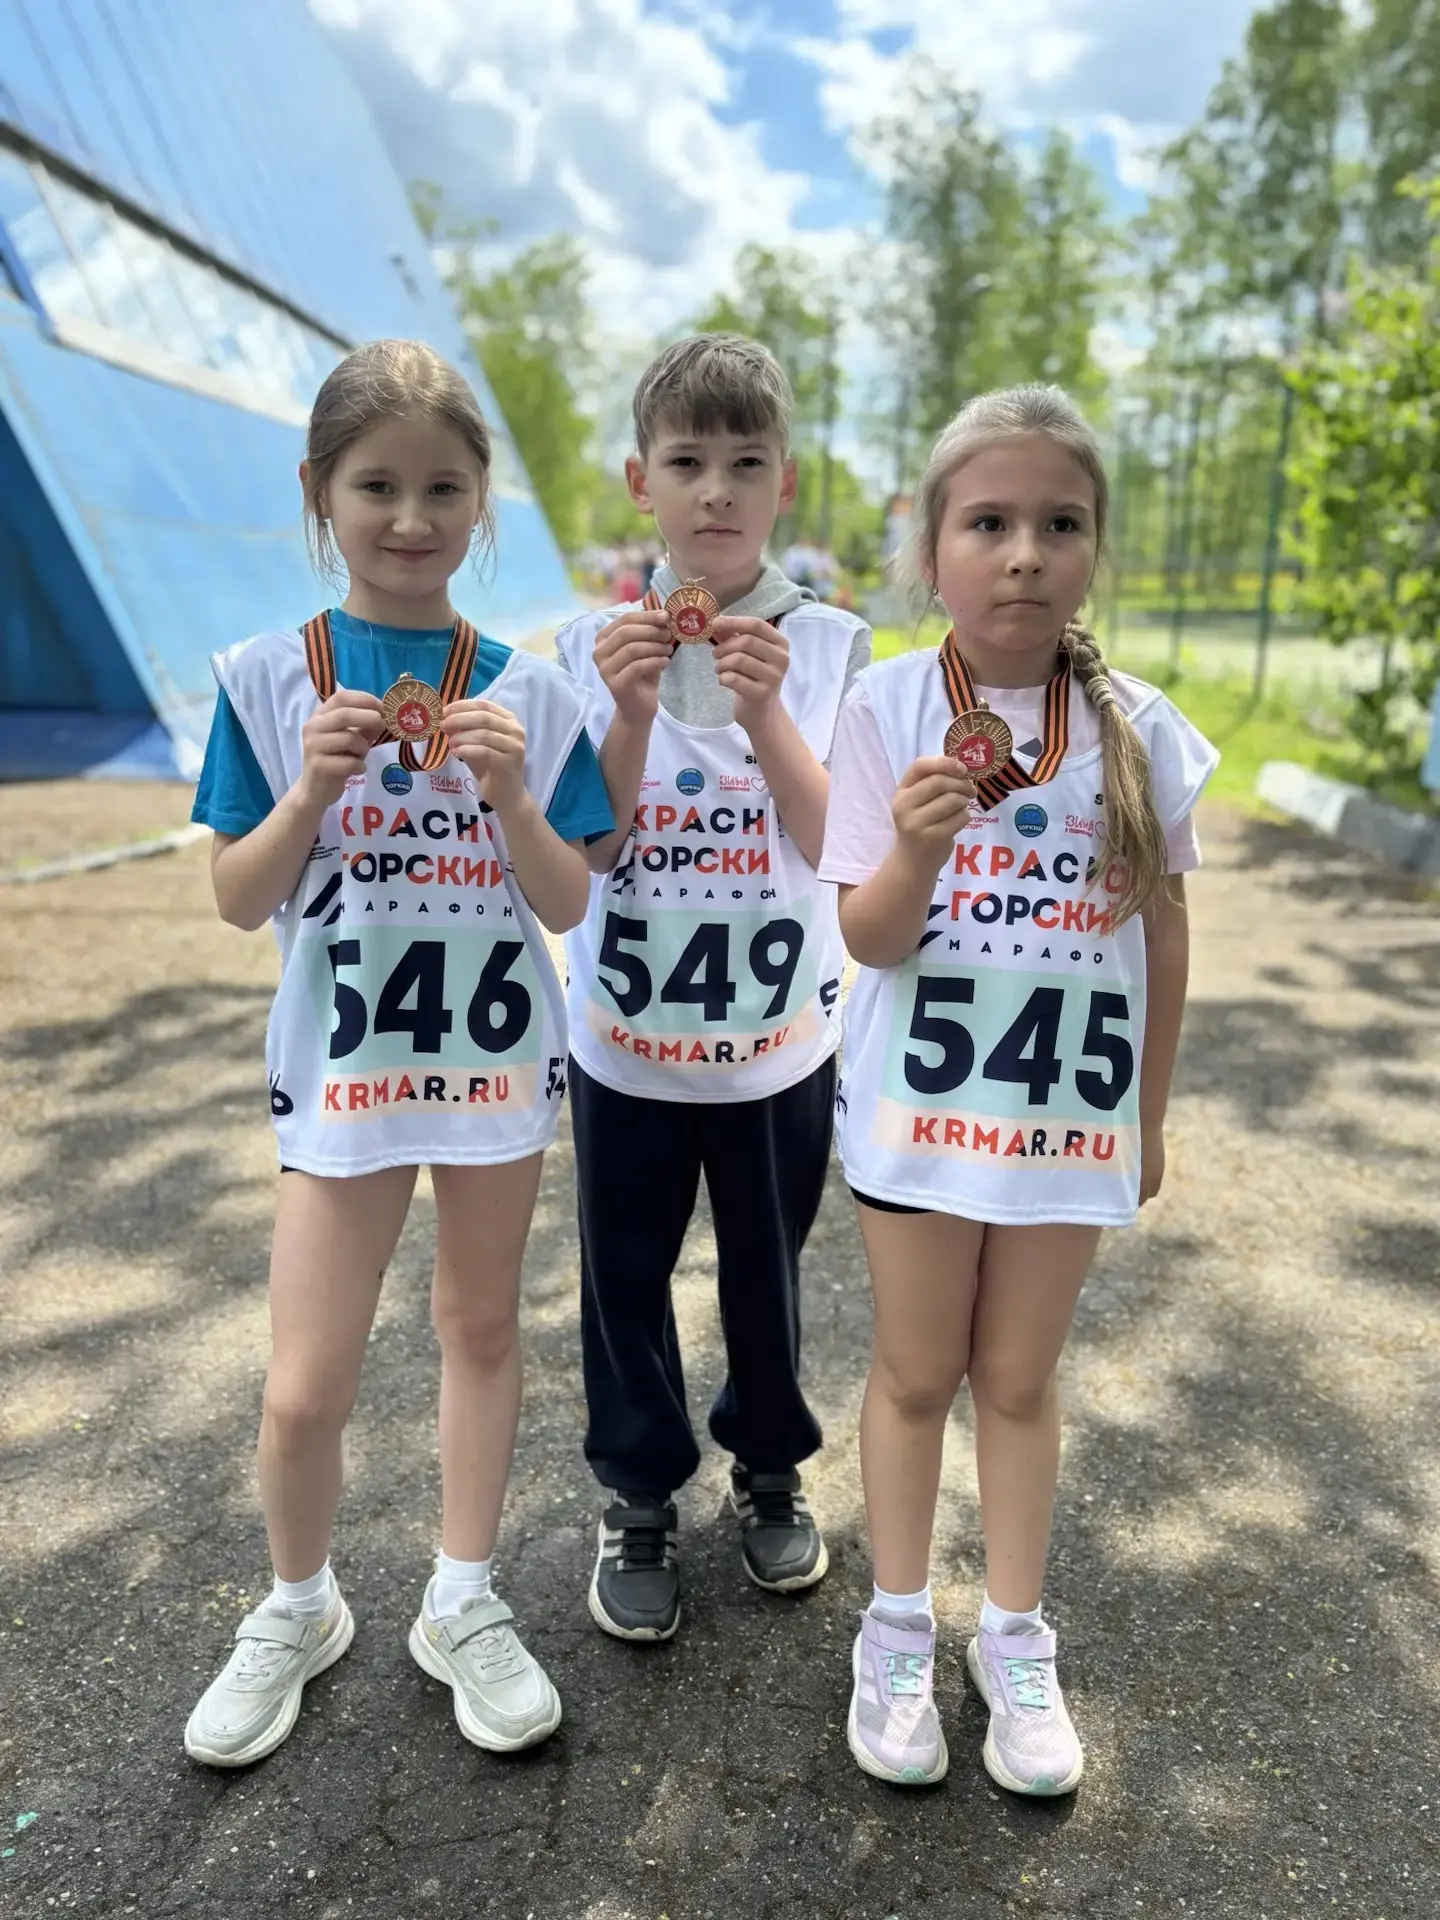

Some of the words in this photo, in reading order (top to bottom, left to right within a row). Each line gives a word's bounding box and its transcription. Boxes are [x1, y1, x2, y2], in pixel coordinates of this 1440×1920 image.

[633, 887, 776, 900] АРАФОН
[597, 910, 805, 1022] 549
[327, 939, 532, 1060] 546
[611, 1024, 791, 1064] KRMAR.RU
[904, 975, 1135, 1112] 545
[324, 1074, 509, 1111] KRMAR.RU
[912, 1116, 1116, 1161] KRMAR.RU
